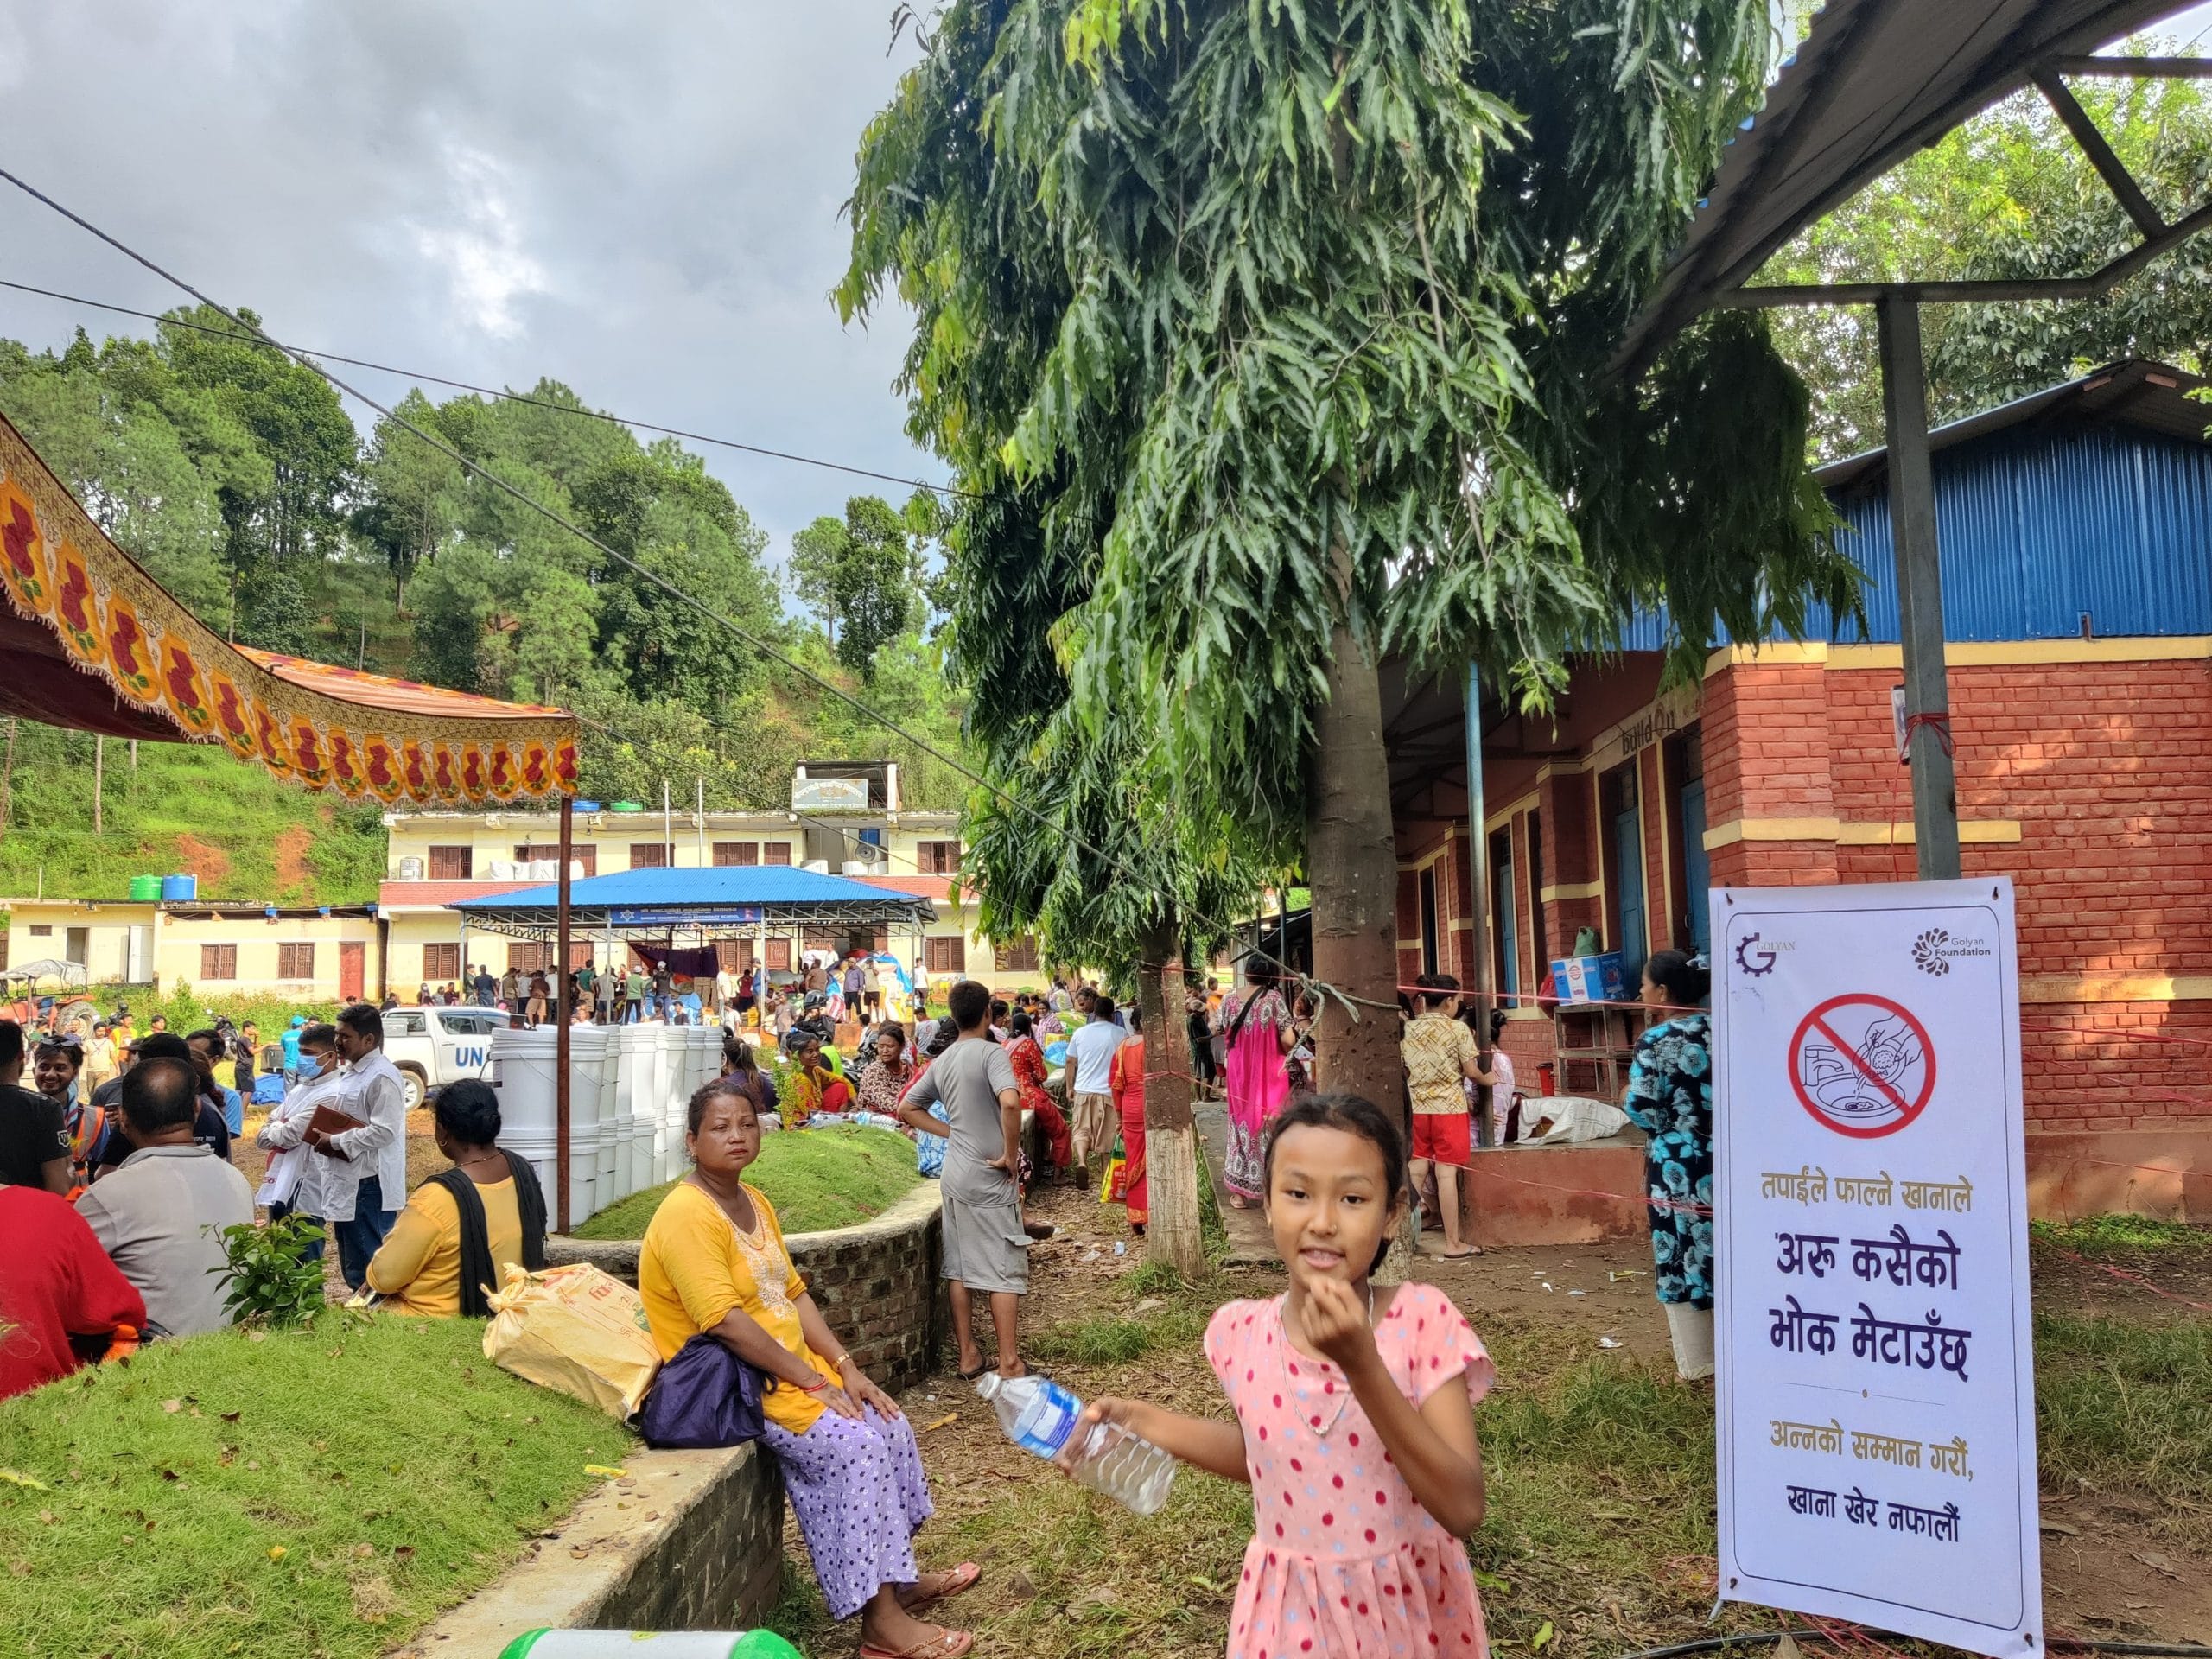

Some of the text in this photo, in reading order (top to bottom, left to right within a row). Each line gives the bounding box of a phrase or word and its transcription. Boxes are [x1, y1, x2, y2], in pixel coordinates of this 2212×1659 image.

[1756, 940, 1796, 951] GOLYAN
[1935, 948, 1991, 957] Foundation
[1950, 935, 1985, 948] Golyan
[455, 1047, 483, 1067] UN
[1834, 1170, 1893, 1206] फाल्ने
[1899, 1174, 1973, 1212] खानाले
[1774, 1223, 1961, 1290] अरू कसैको
[1768, 1294, 1971, 1382] भोक मेटाउँछ
[1769, 1418, 1844, 1455] अन्नको
[1850, 1431, 1923, 1468] सम्मान
[1786, 1484, 1960, 1542] खाना खेर नफालौं
